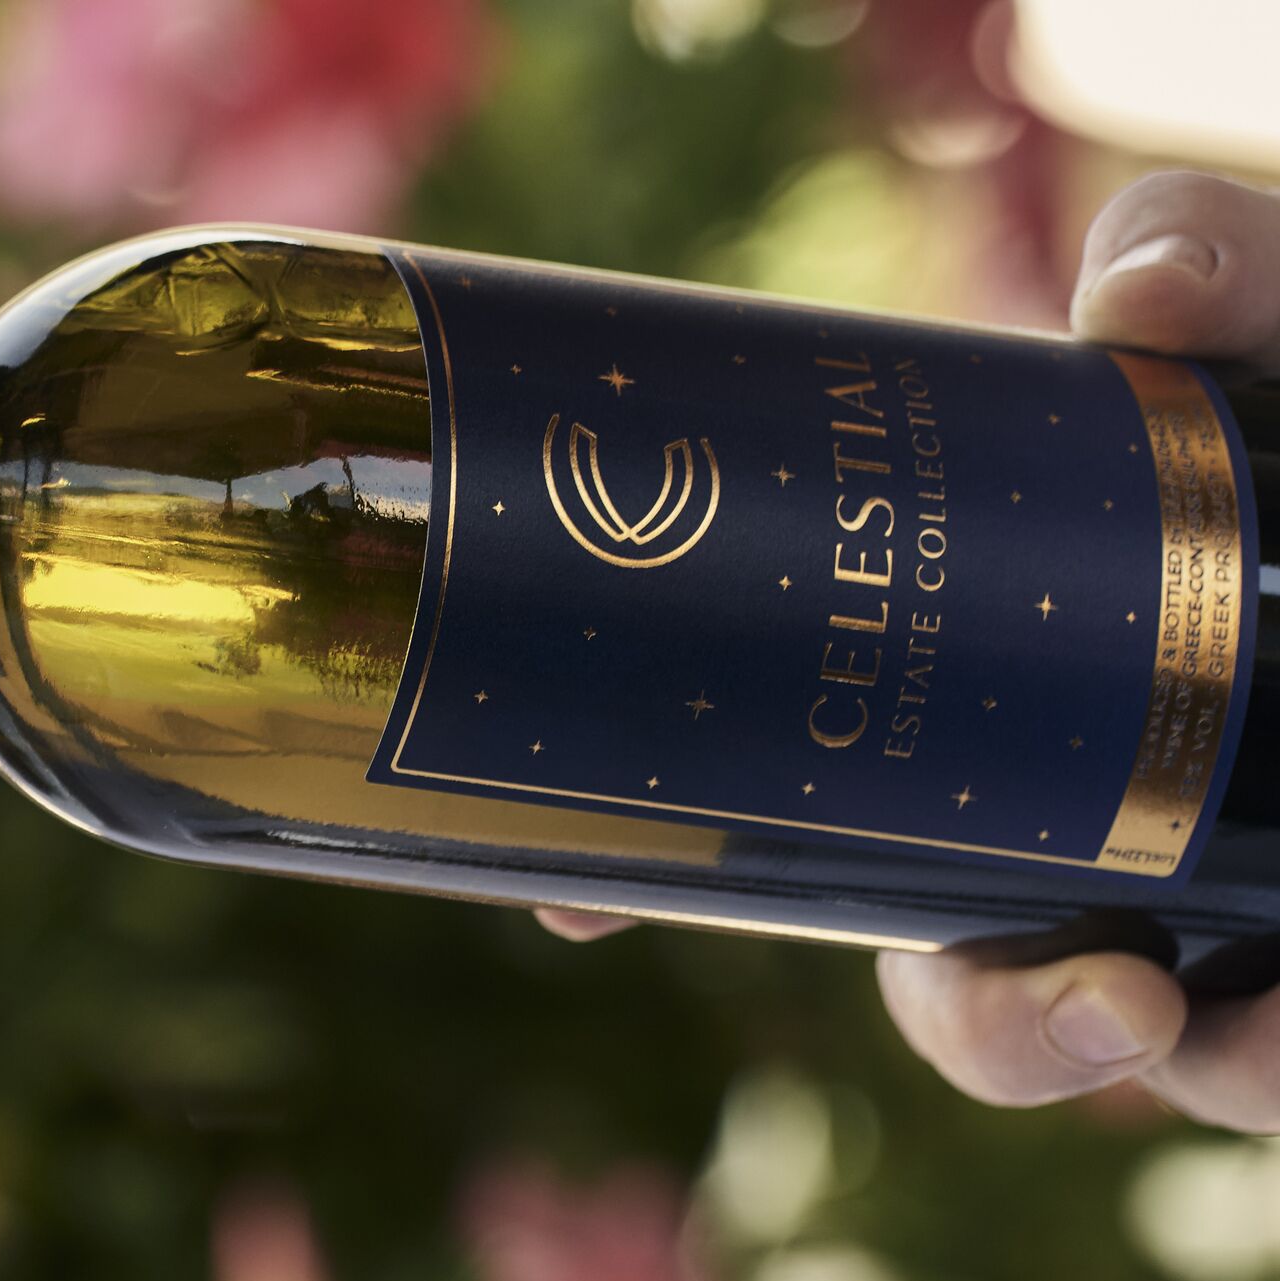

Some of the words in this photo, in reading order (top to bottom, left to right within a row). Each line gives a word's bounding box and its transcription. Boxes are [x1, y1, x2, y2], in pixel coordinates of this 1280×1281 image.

[895, 357, 947, 592] COLLECTION
[1207, 472, 1235, 582] PRODUCT
[808, 351, 895, 749] CELESTIAL
[1163, 549, 1183, 641] BOTTLED
[884, 611, 941, 759] ESTATE
[1162, 647, 1177, 662] &
[1207, 594, 1230, 677] GREEK
[1135, 667, 1171, 779] PRODUCED
[1161, 714, 1188, 769] WINE
[1175, 679, 1192, 710] OF
